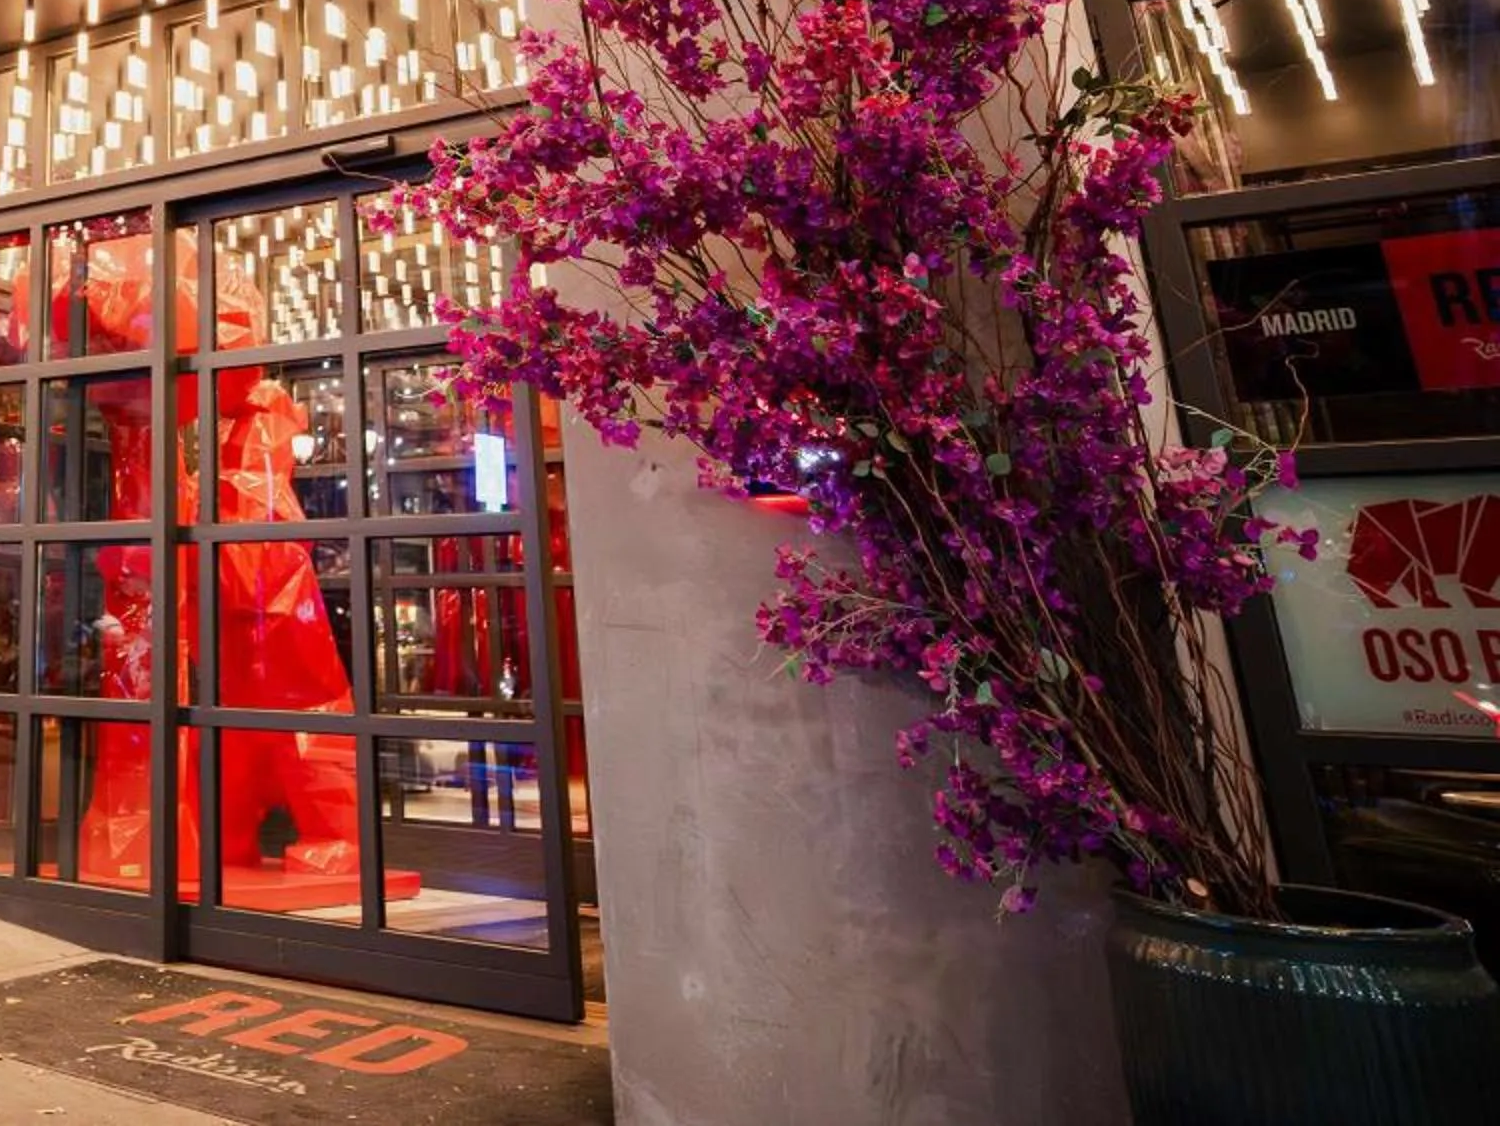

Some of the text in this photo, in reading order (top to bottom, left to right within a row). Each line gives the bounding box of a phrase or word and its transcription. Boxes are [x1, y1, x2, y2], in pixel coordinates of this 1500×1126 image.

[1261, 307, 1357, 337] MADRID
[1362, 628, 1470, 683] OSO
[130, 990, 469, 1074] RED
[85, 1036, 307, 1095] Radisson
